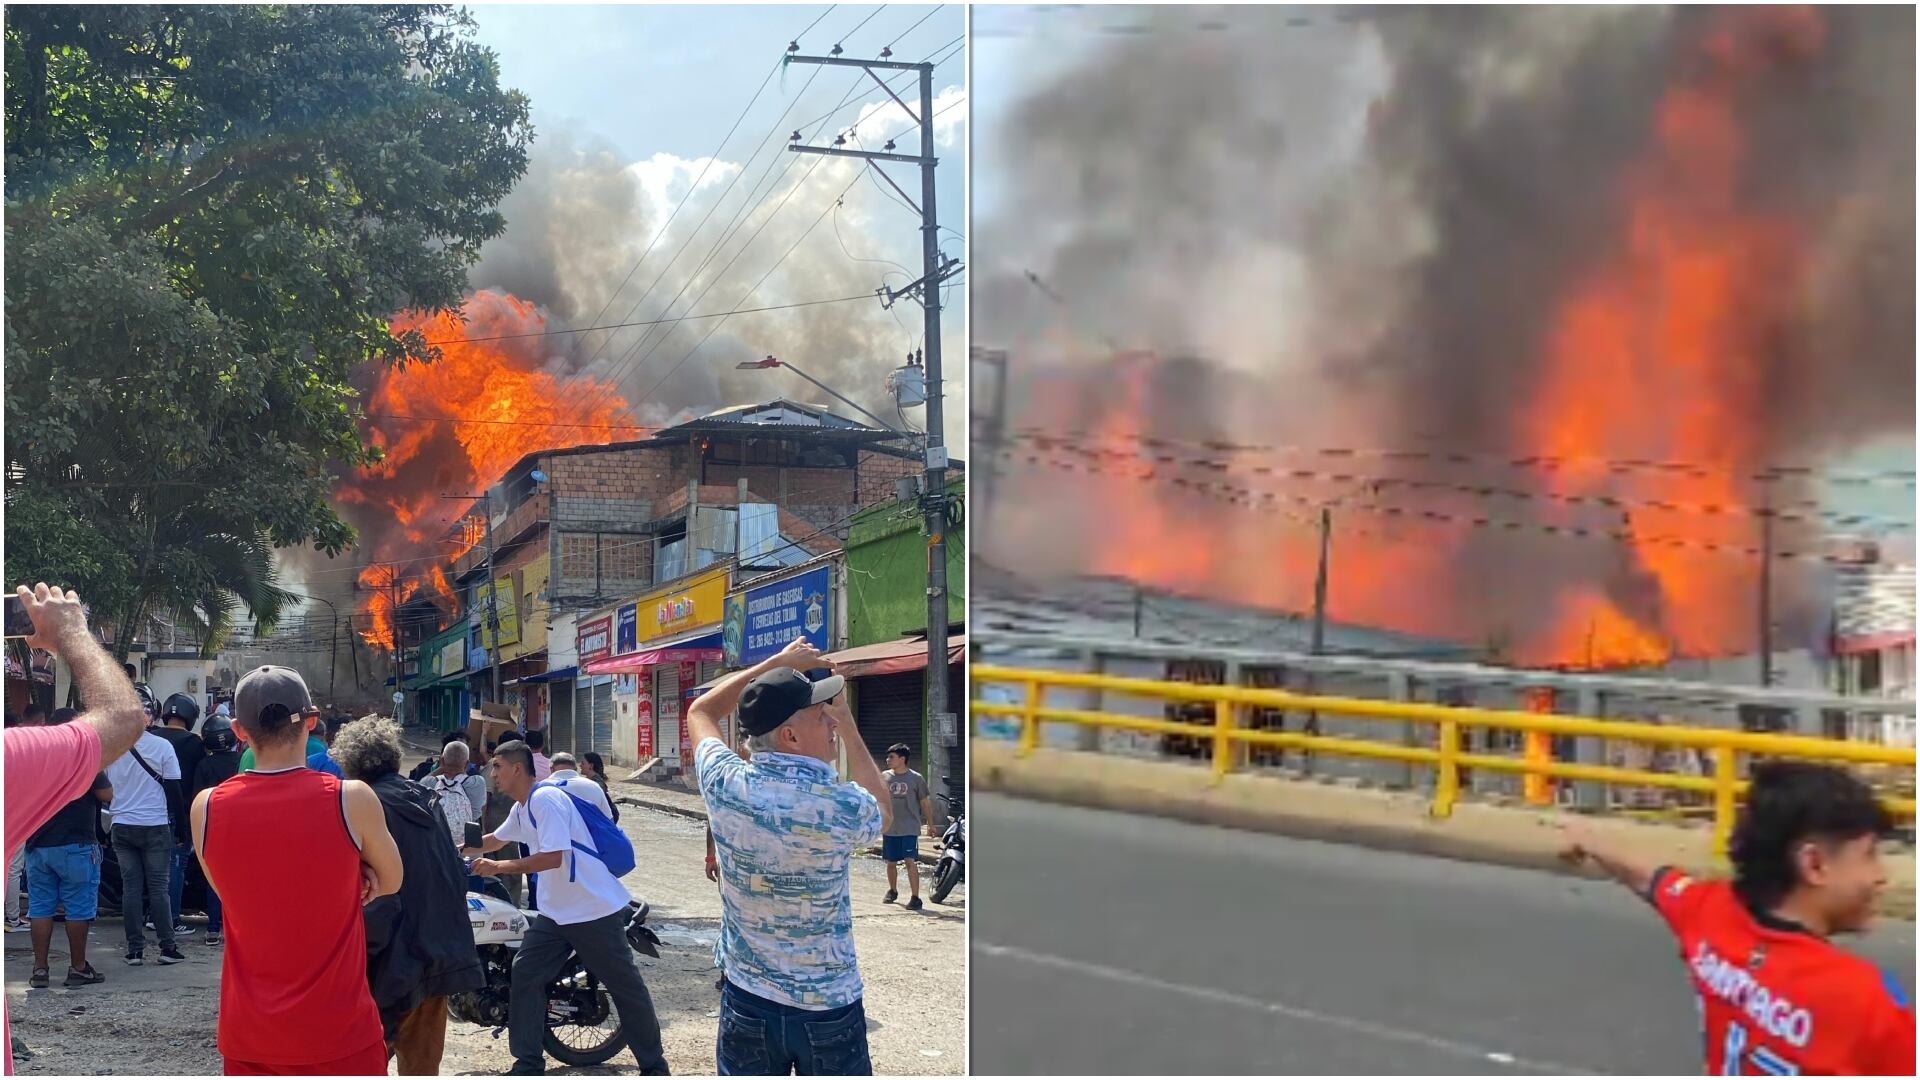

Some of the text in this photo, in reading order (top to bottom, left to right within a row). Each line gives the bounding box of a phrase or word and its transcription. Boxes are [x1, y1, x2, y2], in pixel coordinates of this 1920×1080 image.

[775, 592, 782, 607] DE
[782, 586, 803, 605] GASEOSAS
[774, 610, 782, 625] DEL
[782, 606, 798, 623] TOLIMA
[1690, 941, 1812, 1048] SANTIAGO
